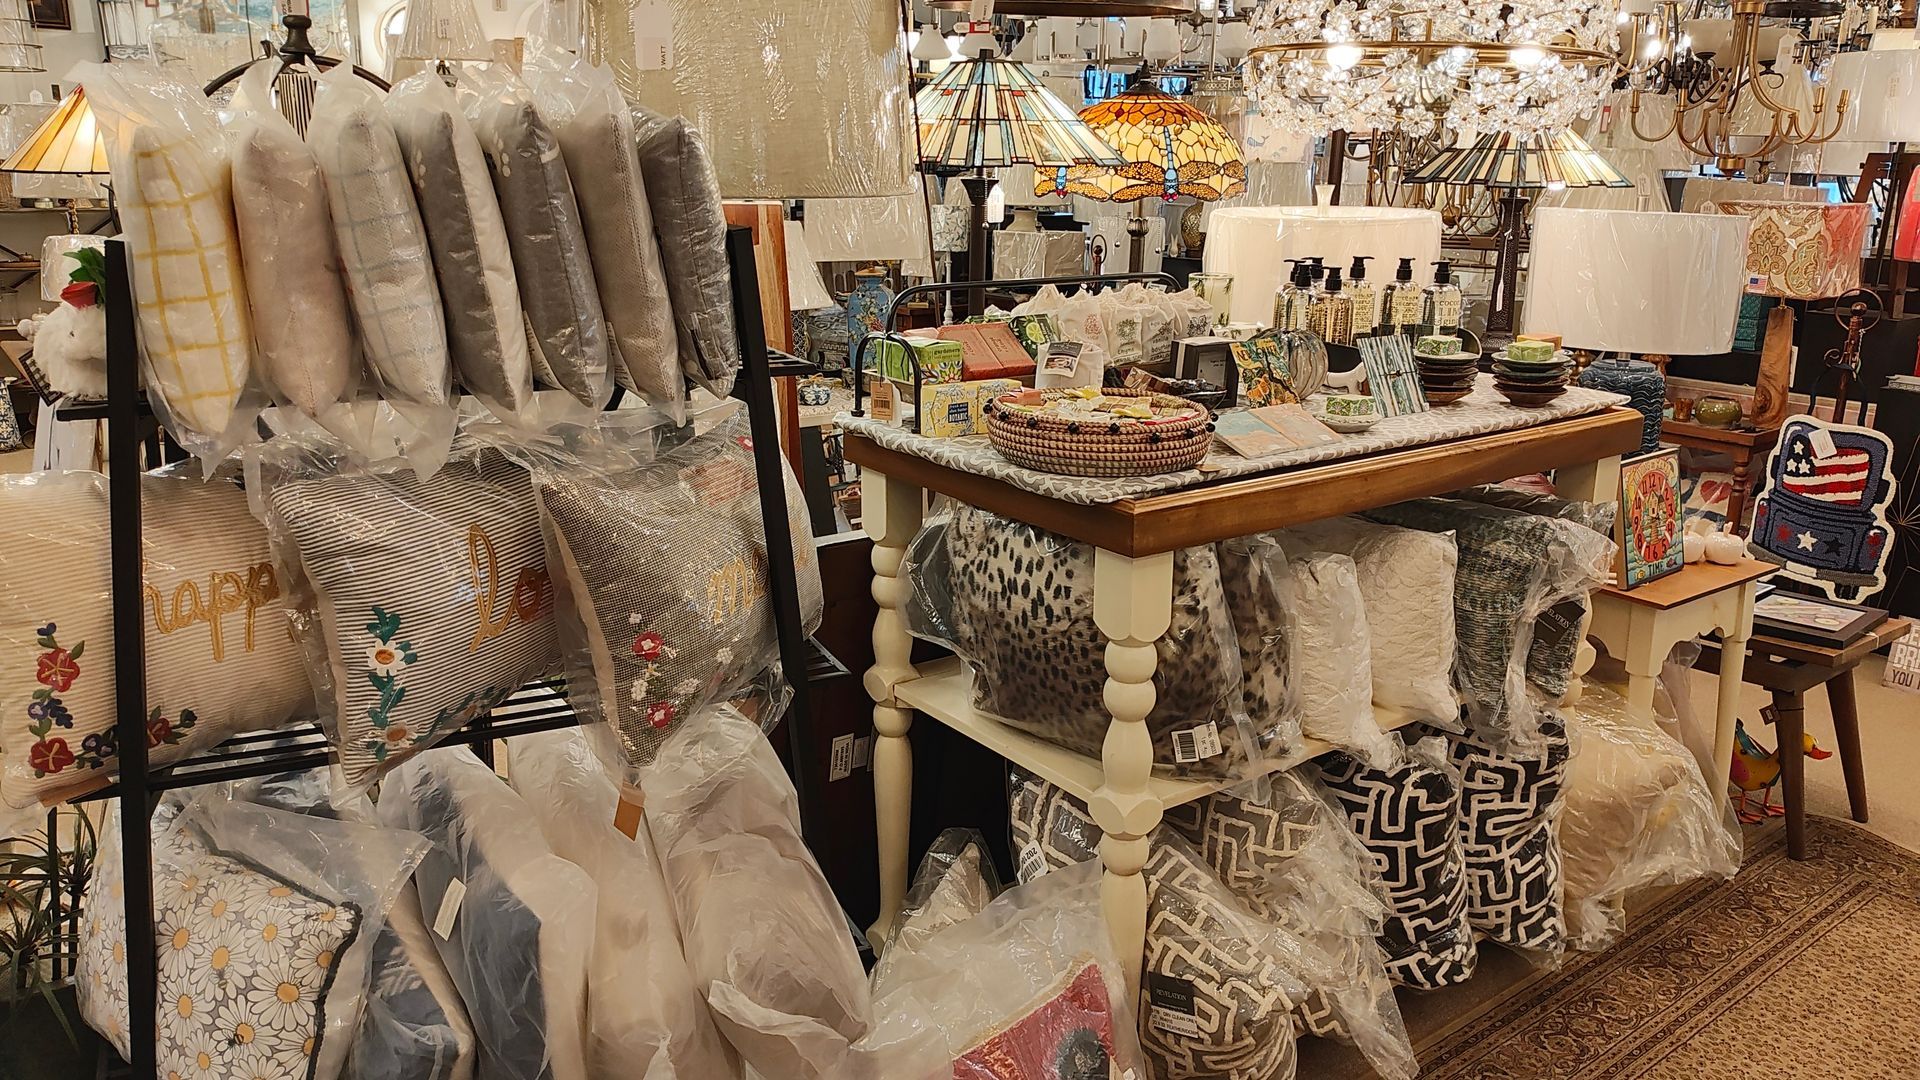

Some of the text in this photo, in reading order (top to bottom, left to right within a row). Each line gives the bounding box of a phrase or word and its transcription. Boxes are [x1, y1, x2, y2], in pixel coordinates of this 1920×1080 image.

[1642, 480, 1648, 496] 11
[1649, 473, 1656, 488] 12
[1665, 488, 1669, 500] 2
[1634, 496, 1642, 510] 10
[1668, 504, 1673, 517] 3
[1634, 516, 1639, 531] 9
[1637, 533, 1643, 550] 8
[1662, 540, 1667, 553] 5
[1653, 545, 1658, 560] 6
[1648, 560, 1666, 577] TIME
[1547, 608, 1570, 629] ELATION
[1893, 643, 1920, 671] BR
[1892, 669, 1914, 688] YOU
